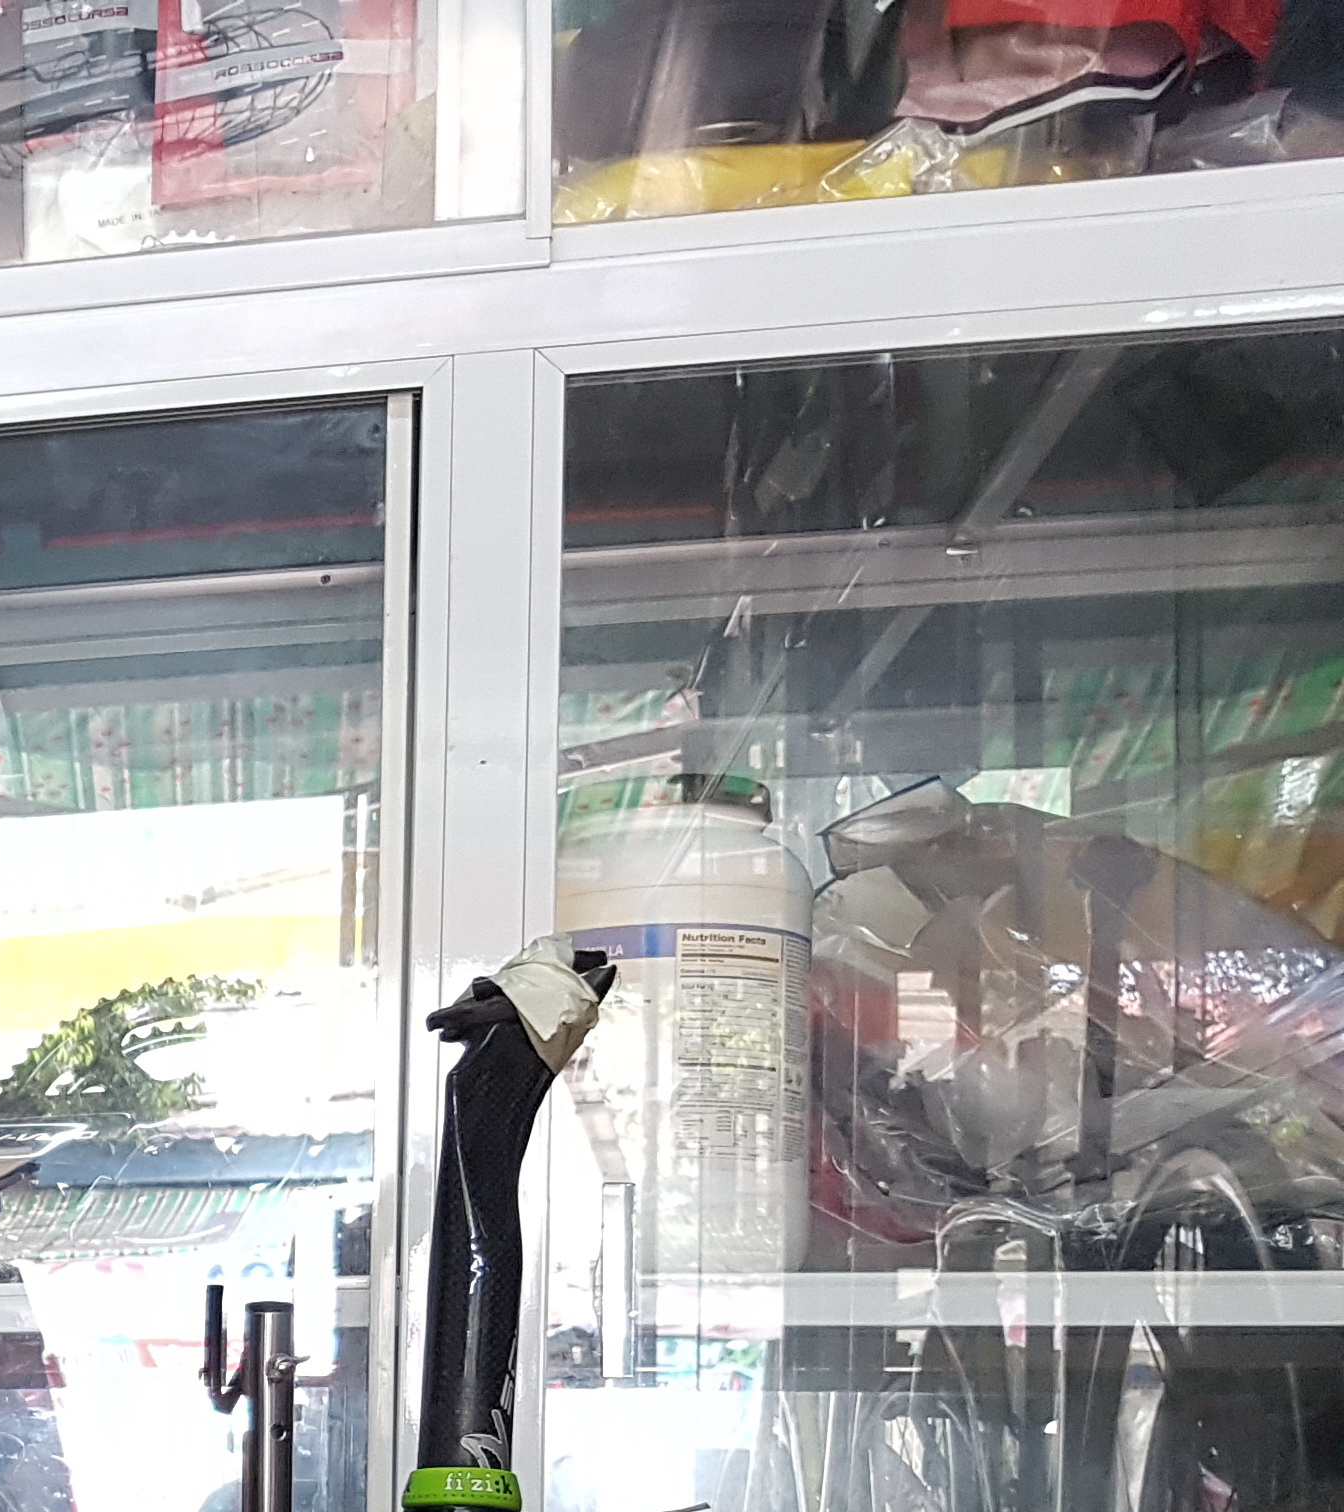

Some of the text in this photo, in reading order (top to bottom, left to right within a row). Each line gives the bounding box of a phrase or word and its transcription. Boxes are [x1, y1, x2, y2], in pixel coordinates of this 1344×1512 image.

[97, 216, 126, 229] MADE
[131, 213, 143, 223] IN
[681, 932, 767, 947] Nutrition Facts
